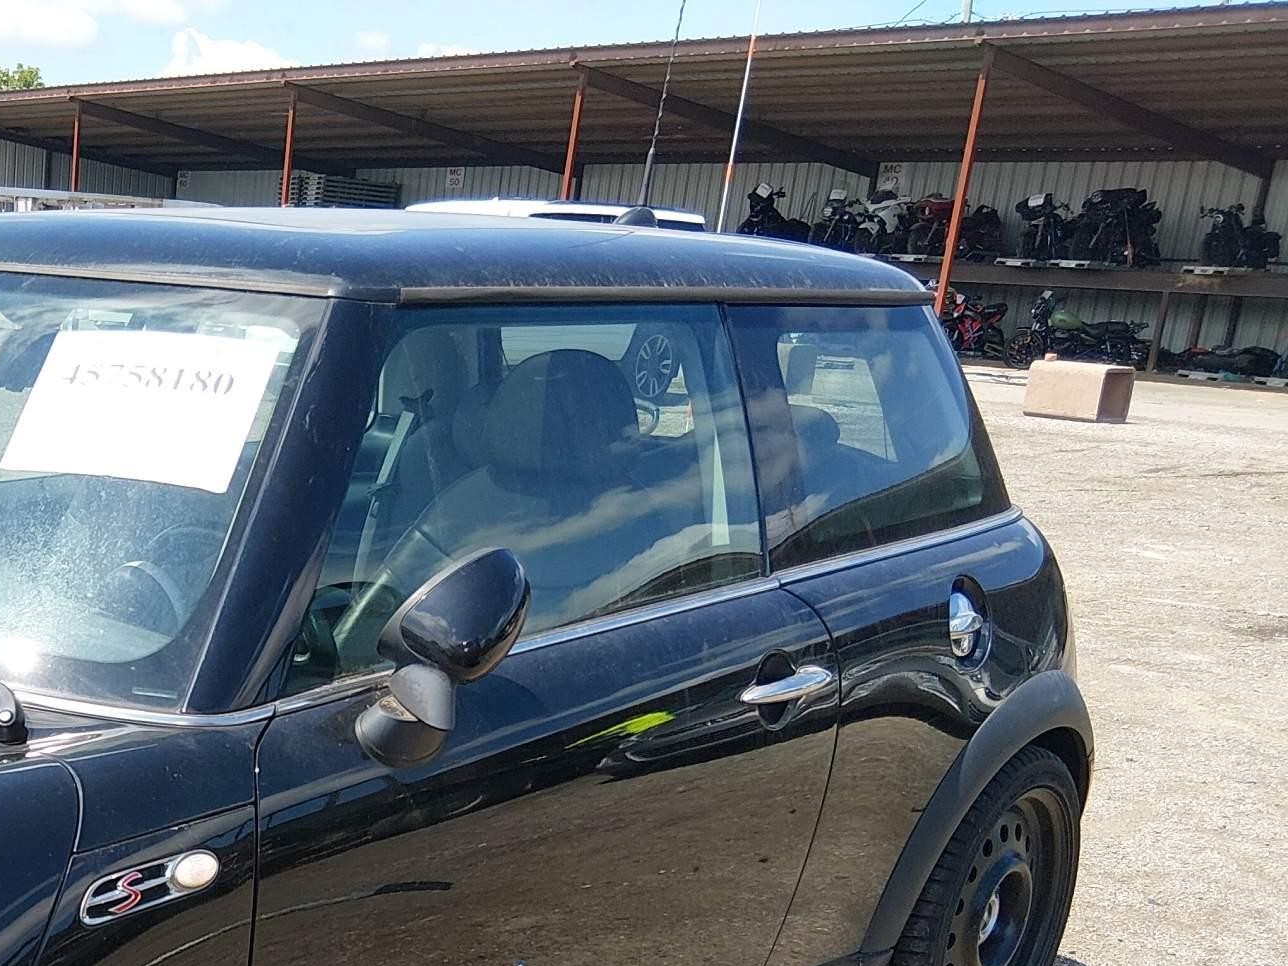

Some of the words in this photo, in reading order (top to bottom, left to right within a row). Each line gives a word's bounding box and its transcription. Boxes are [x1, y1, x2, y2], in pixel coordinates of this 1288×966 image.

[883, 164, 902, 174] MC
[448, 178, 460, 186] 50
[108, 871, 143, 914] S
